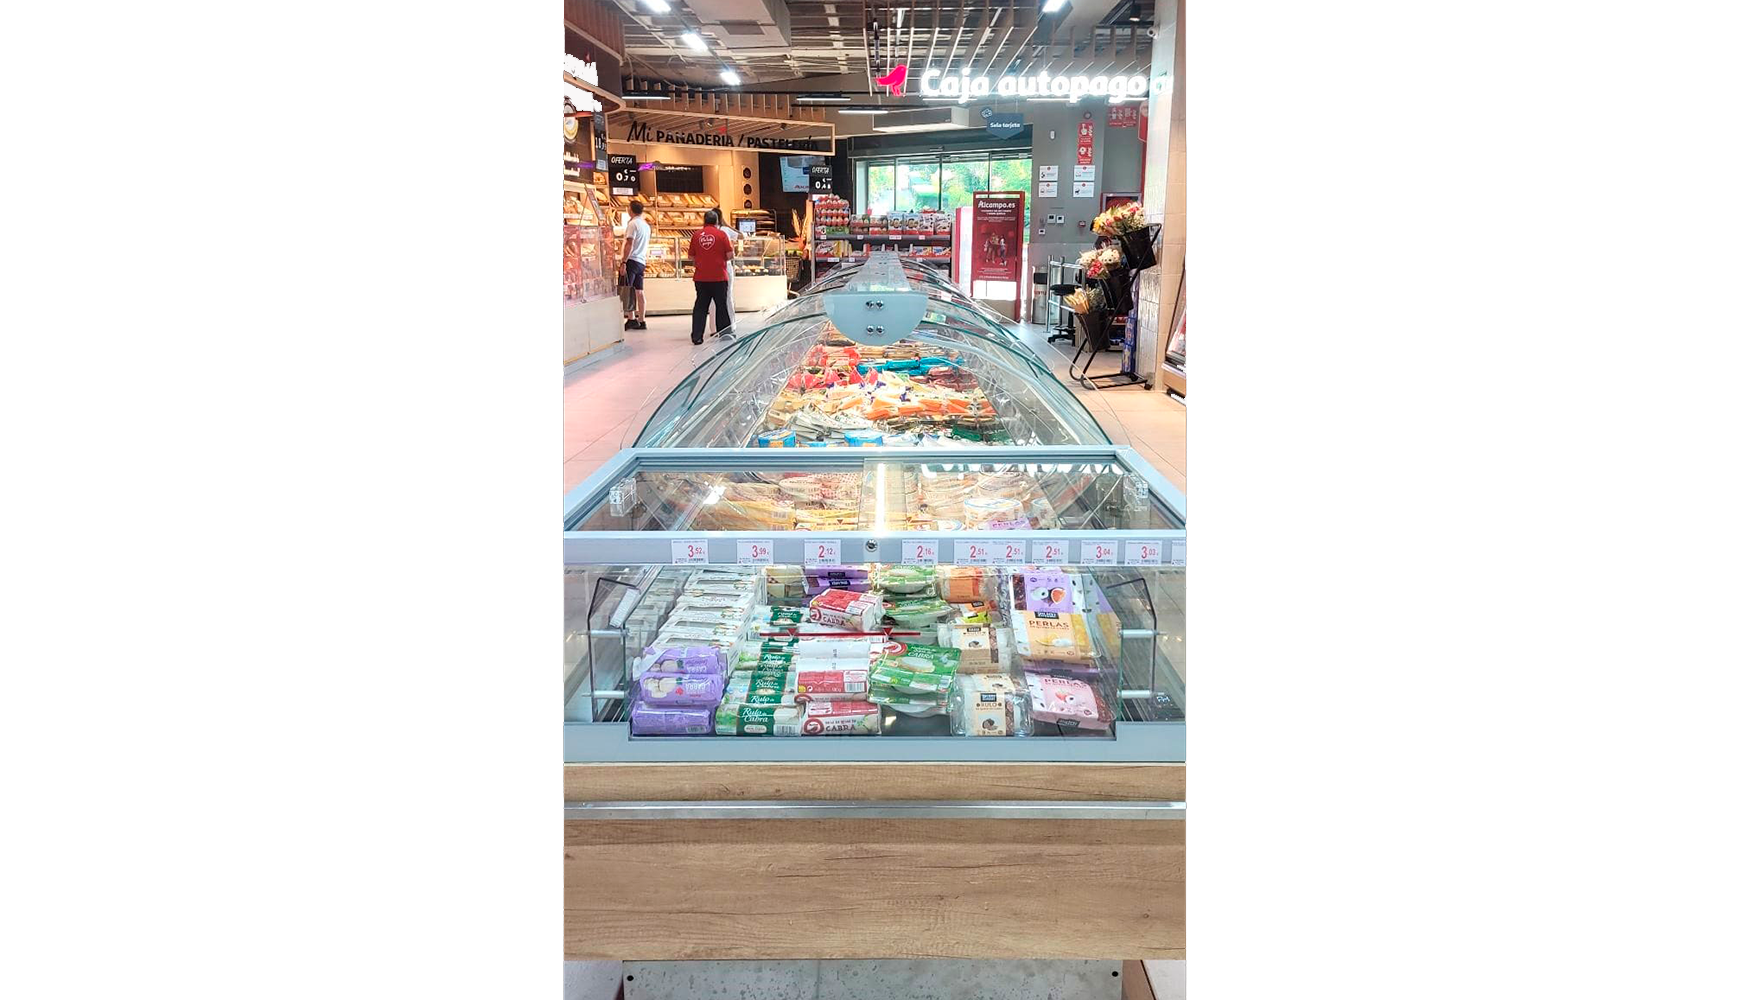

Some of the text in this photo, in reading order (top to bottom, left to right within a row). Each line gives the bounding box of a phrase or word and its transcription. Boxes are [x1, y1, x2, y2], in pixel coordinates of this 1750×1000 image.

[921, 66, 1148, 104] Caja autopago
[627, 120, 653, 143] Mi
[611, 155, 634, 165] OFERTA
[977, 200, 1016, 210] Alcampo.es
[1028, 620, 1070, 628] PERLAS
[742, 707, 762, 717] Rulo
[825, 724, 856, 732] CABRA
